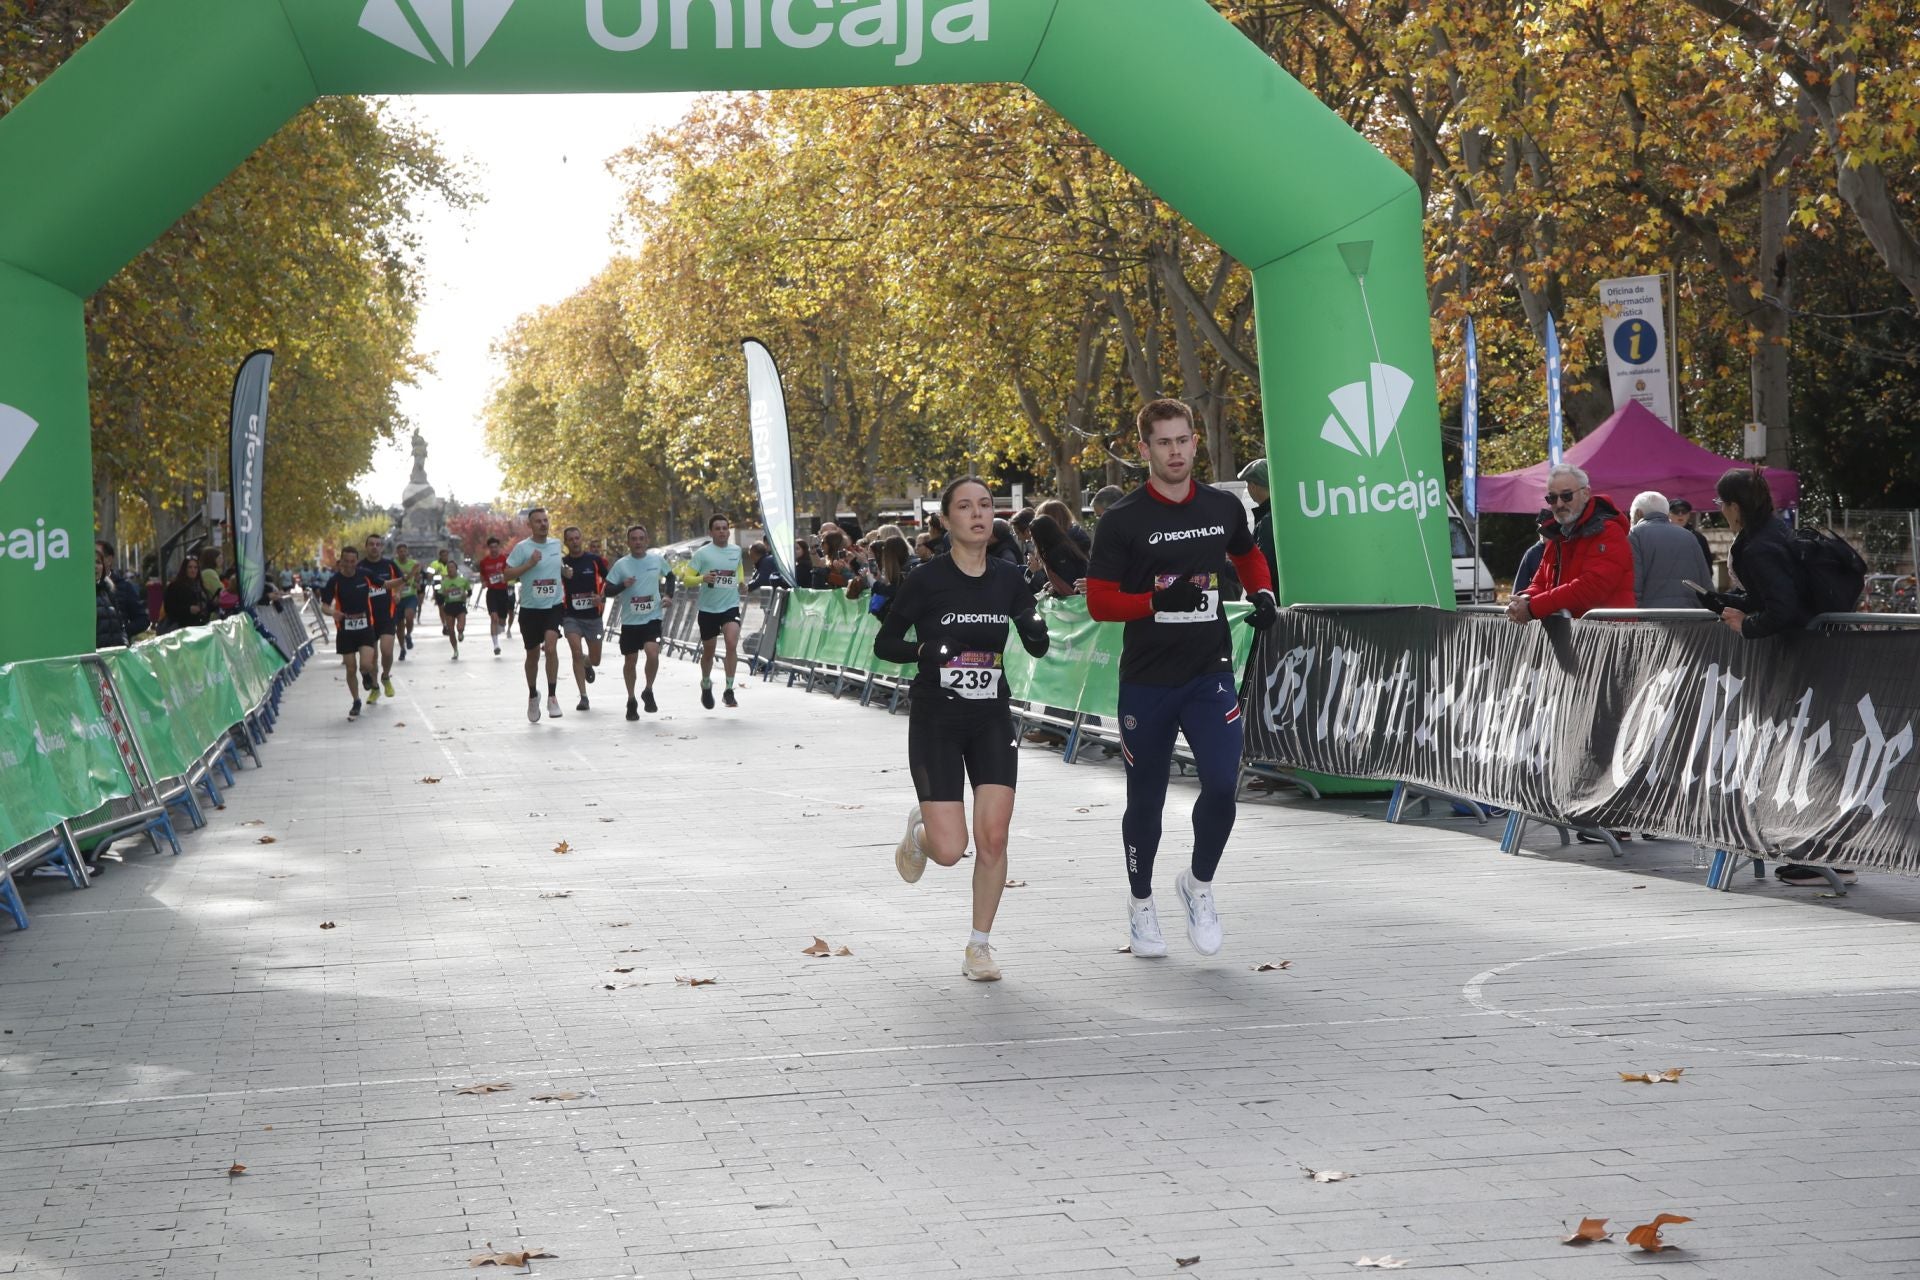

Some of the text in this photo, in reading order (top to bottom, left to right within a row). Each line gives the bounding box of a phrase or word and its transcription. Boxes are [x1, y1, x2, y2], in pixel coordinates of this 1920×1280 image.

[585, 0, 989, 66] Unicaja
[1607, 285, 1645, 296] Oficina de
[1298, 470, 1441, 520] Unicaja
[1163, 526, 1225, 542] DECATHLON
[0, 517, 70, 571] aja
[715, 576, 733, 585] 796
[536, 586, 555, 594] 795
[634, 602, 652, 611] 794
[347, 619, 364, 627] 474
[957, 613, 1009, 624] DECATHLON
[950, 669, 993, 690] 239
[1681, 662, 1832, 814] Norte
[1837, 693, 1914, 821] de
[1128, 844, 1138, 874] PARIS
